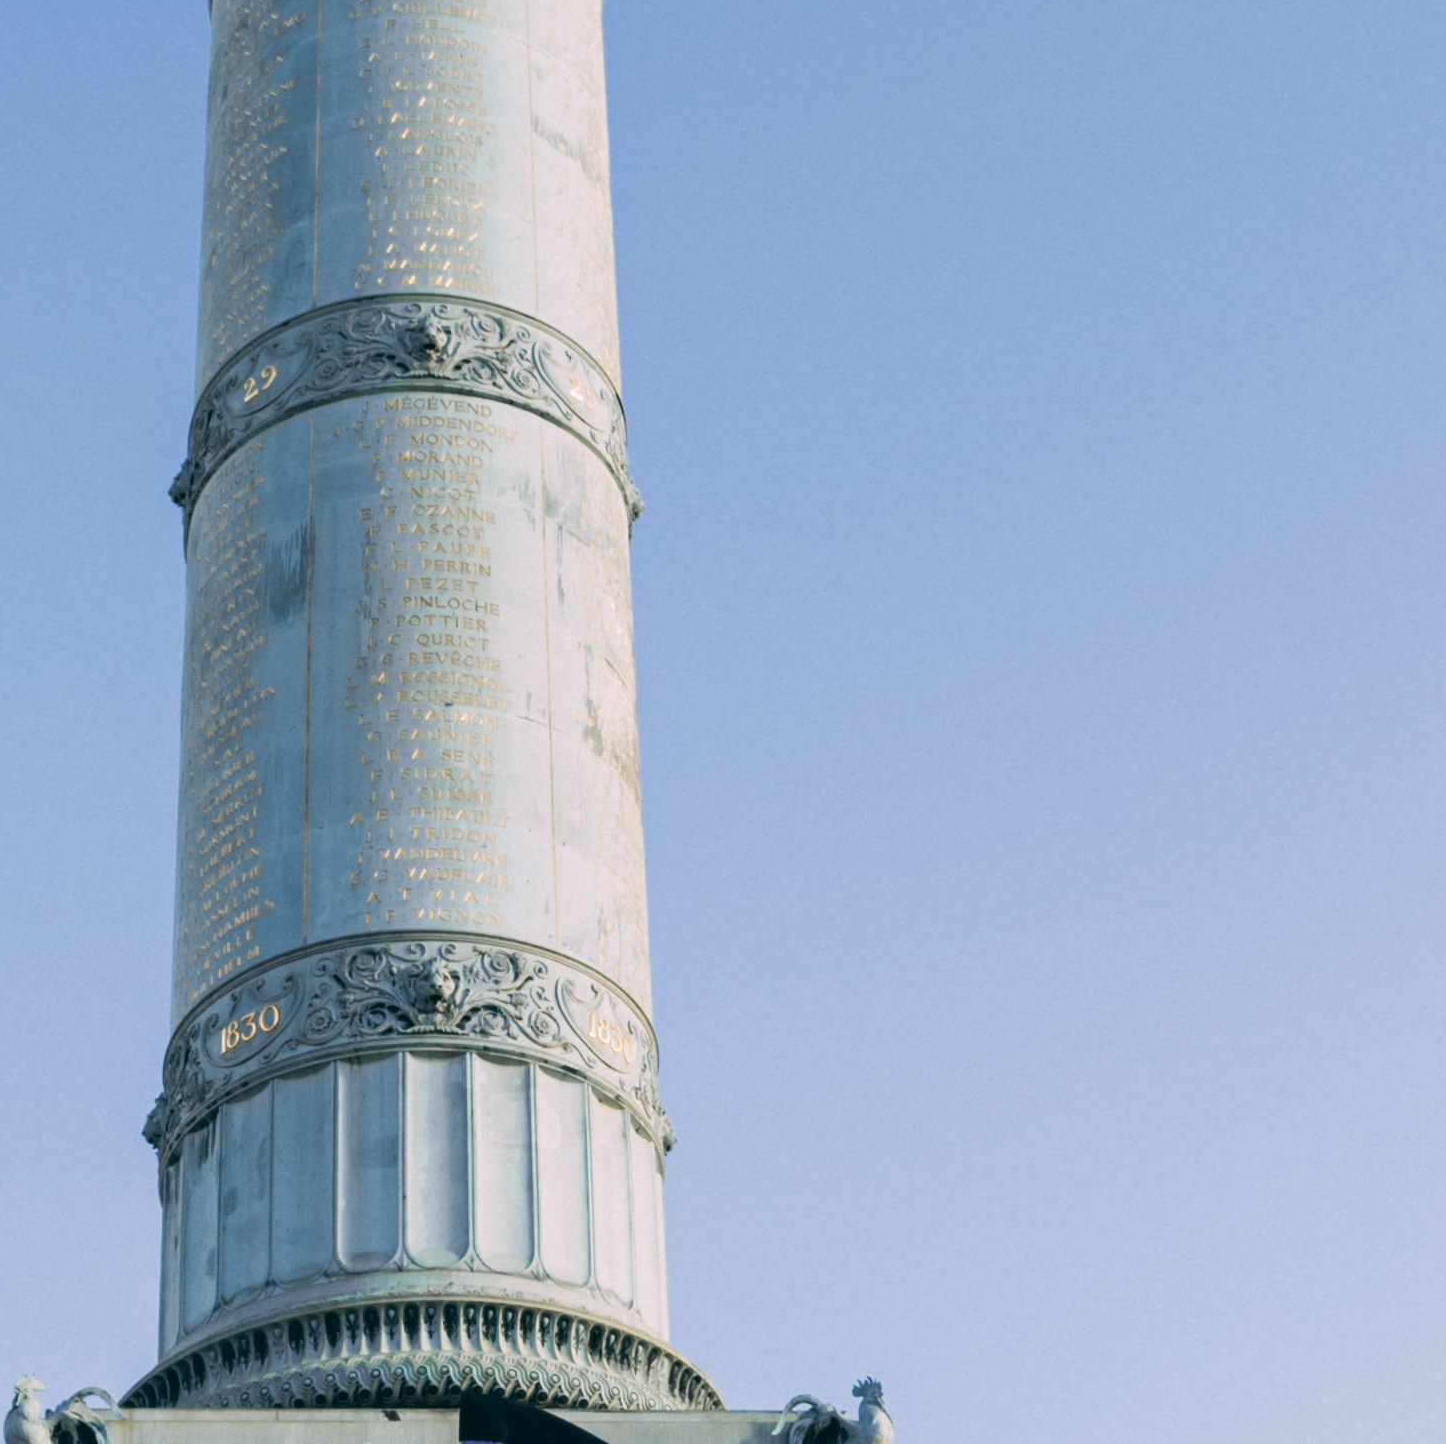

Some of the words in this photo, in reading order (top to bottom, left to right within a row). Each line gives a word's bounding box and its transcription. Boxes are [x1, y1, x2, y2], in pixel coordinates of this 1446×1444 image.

[412, 19, 464, 33] HELL
[242, 365, 278, 404] 29
[384, 395, 492, 417] MÉGÉVEND
[410, 433, 494, 453] MONDON
[398, 450, 483, 468] MORAND
[401, 469, 480, 486] MUNIER
[410, 487, 477, 502] NICOT
[412, 504, 496, 524] OZANNE
[398, 523, 485, 539] PASCOT
[418, 540, 491, 558] PAUPE
[422, 559, 492, 578] PERRIN
[402, 596, 500, 616] PINLOCHE
[396, 615, 487, 632] POTTIER
[416, 633, 489, 651] QURIOT
[400, 671, 509, 693] ROSSIGNOL
[398, 690, 511, 711] ROUSSELET
[413, 708, 499, 729] SALMON
[398, 729, 492, 745] SAUNIER
[401, 767, 490, 784] SIDRAT
[418, 786, 492, 805] SUISSE
[410, 826, 496, 845] TRIDON
[431, 887, 497, 906] VIAL
[413, 909, 502, 927] VIGNON
[219, 1004, 281, 1055] 1830
[587, 1011, 635, 1065] 1830
